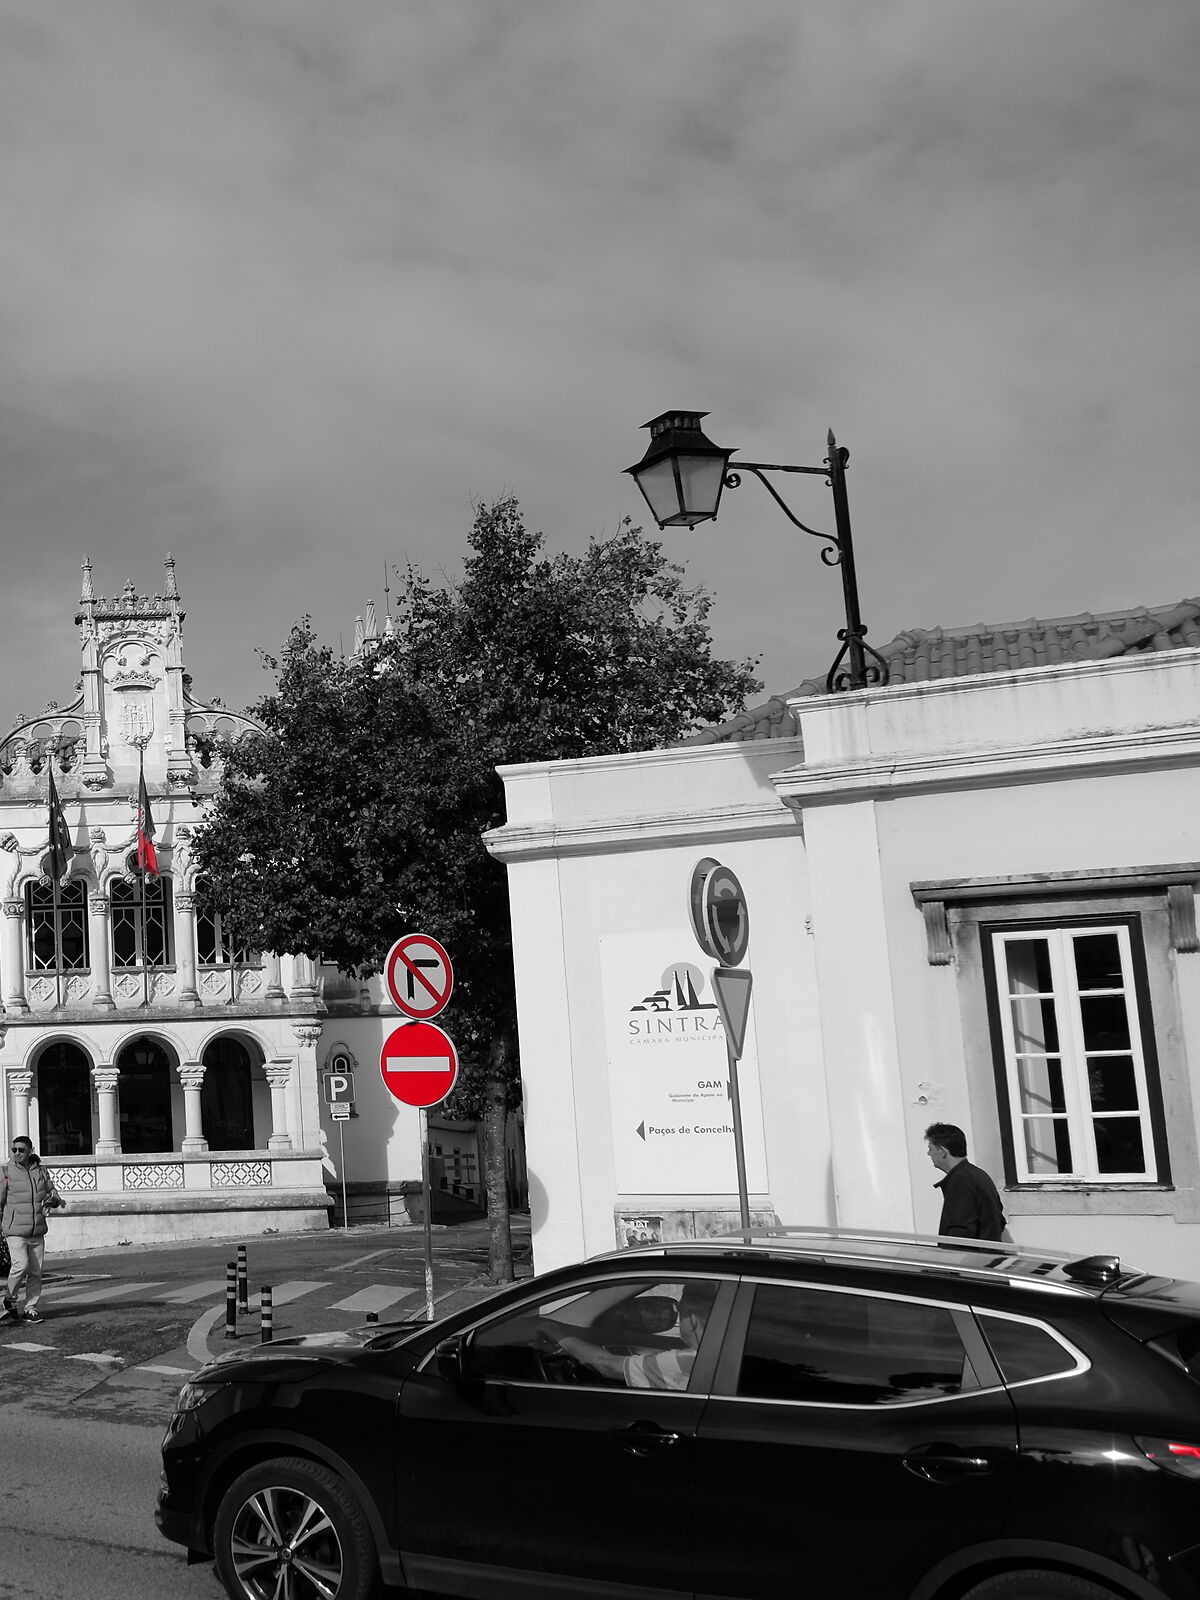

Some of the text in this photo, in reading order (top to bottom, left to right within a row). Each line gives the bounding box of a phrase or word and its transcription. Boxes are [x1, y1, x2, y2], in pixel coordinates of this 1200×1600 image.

[628, 1015, 723, 1035] SINTRA
[675, 1034, 725, 1042] MUNICIPA
[330, 1076, 348, 1101] P
[697, 1080, 722, 1089] GAM
[648, 1126, 676, 1136] Paços
[678, 1125, 691, 1134] de
